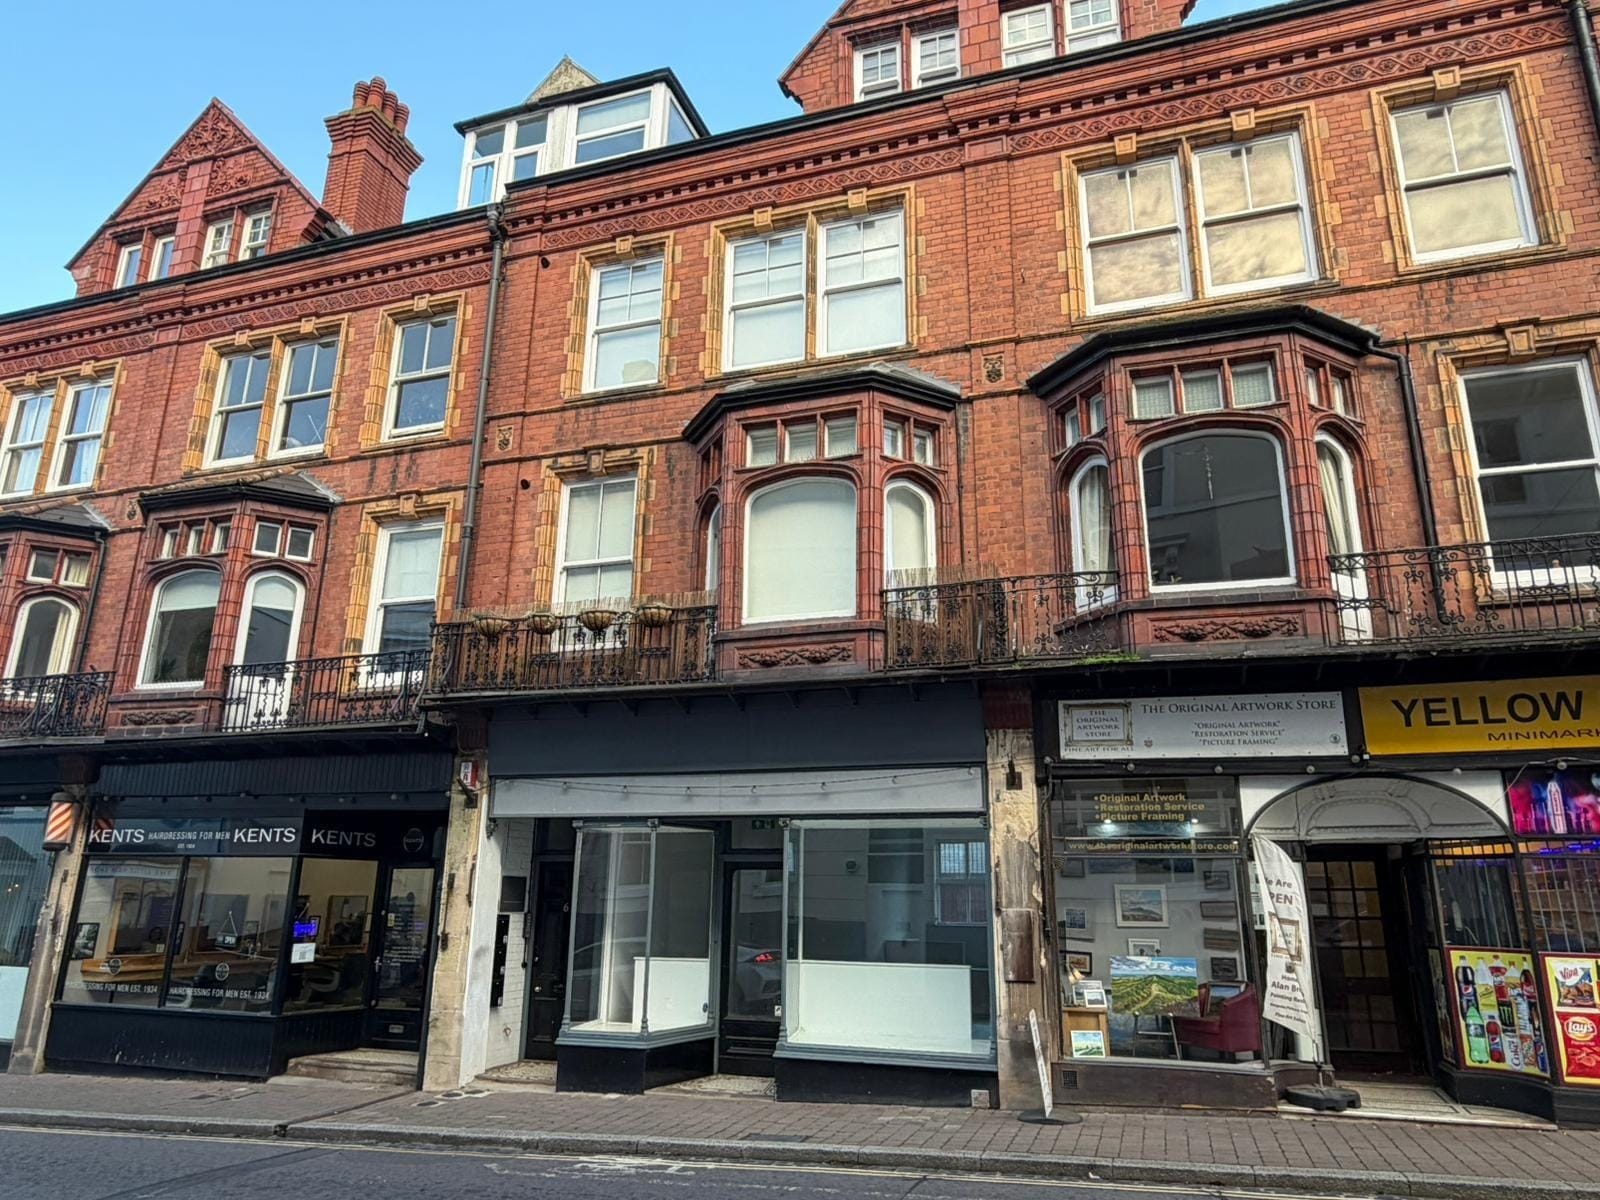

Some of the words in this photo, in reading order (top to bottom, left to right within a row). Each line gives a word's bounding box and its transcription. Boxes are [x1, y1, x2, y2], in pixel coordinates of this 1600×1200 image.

[1141, 704, 1165, 714] THE
[1168, 702, 1228, 714] ORIGINAL
[1230, 700, 1293, 712] ARTWORK
[1297, 699, 1336, 710] STORE
[1391, 690, 1584, 727] YELLOW
[1076, 716, 1119, 724] ORIGINAL
[1100, 794, 1140, 802] Original
[1143, 793, 1185, 801] Artwork
[1100, 804, 1161, 812] Restoration
[1164, 803, 1205, 811] Service
[1100, 812, 1138, 820] Picture
[1141, 812, 1185, 821] Framing
[88, 829, 145, 843] KENTS
[148, 832, 197, 840] HAIRDRESSING
[200, 832, 213, 840] FOR
[215, 831, 230, 840] MEN
[233, 828, 296, 843] KENTS
[311, 829, 376, 847] KENTS
[1276, 879, 1292, 888] Are
[143, 985, 158, 993] 1934
[212, 989, 224, 997] FOR
[225, 989, 238, 998] MEN
